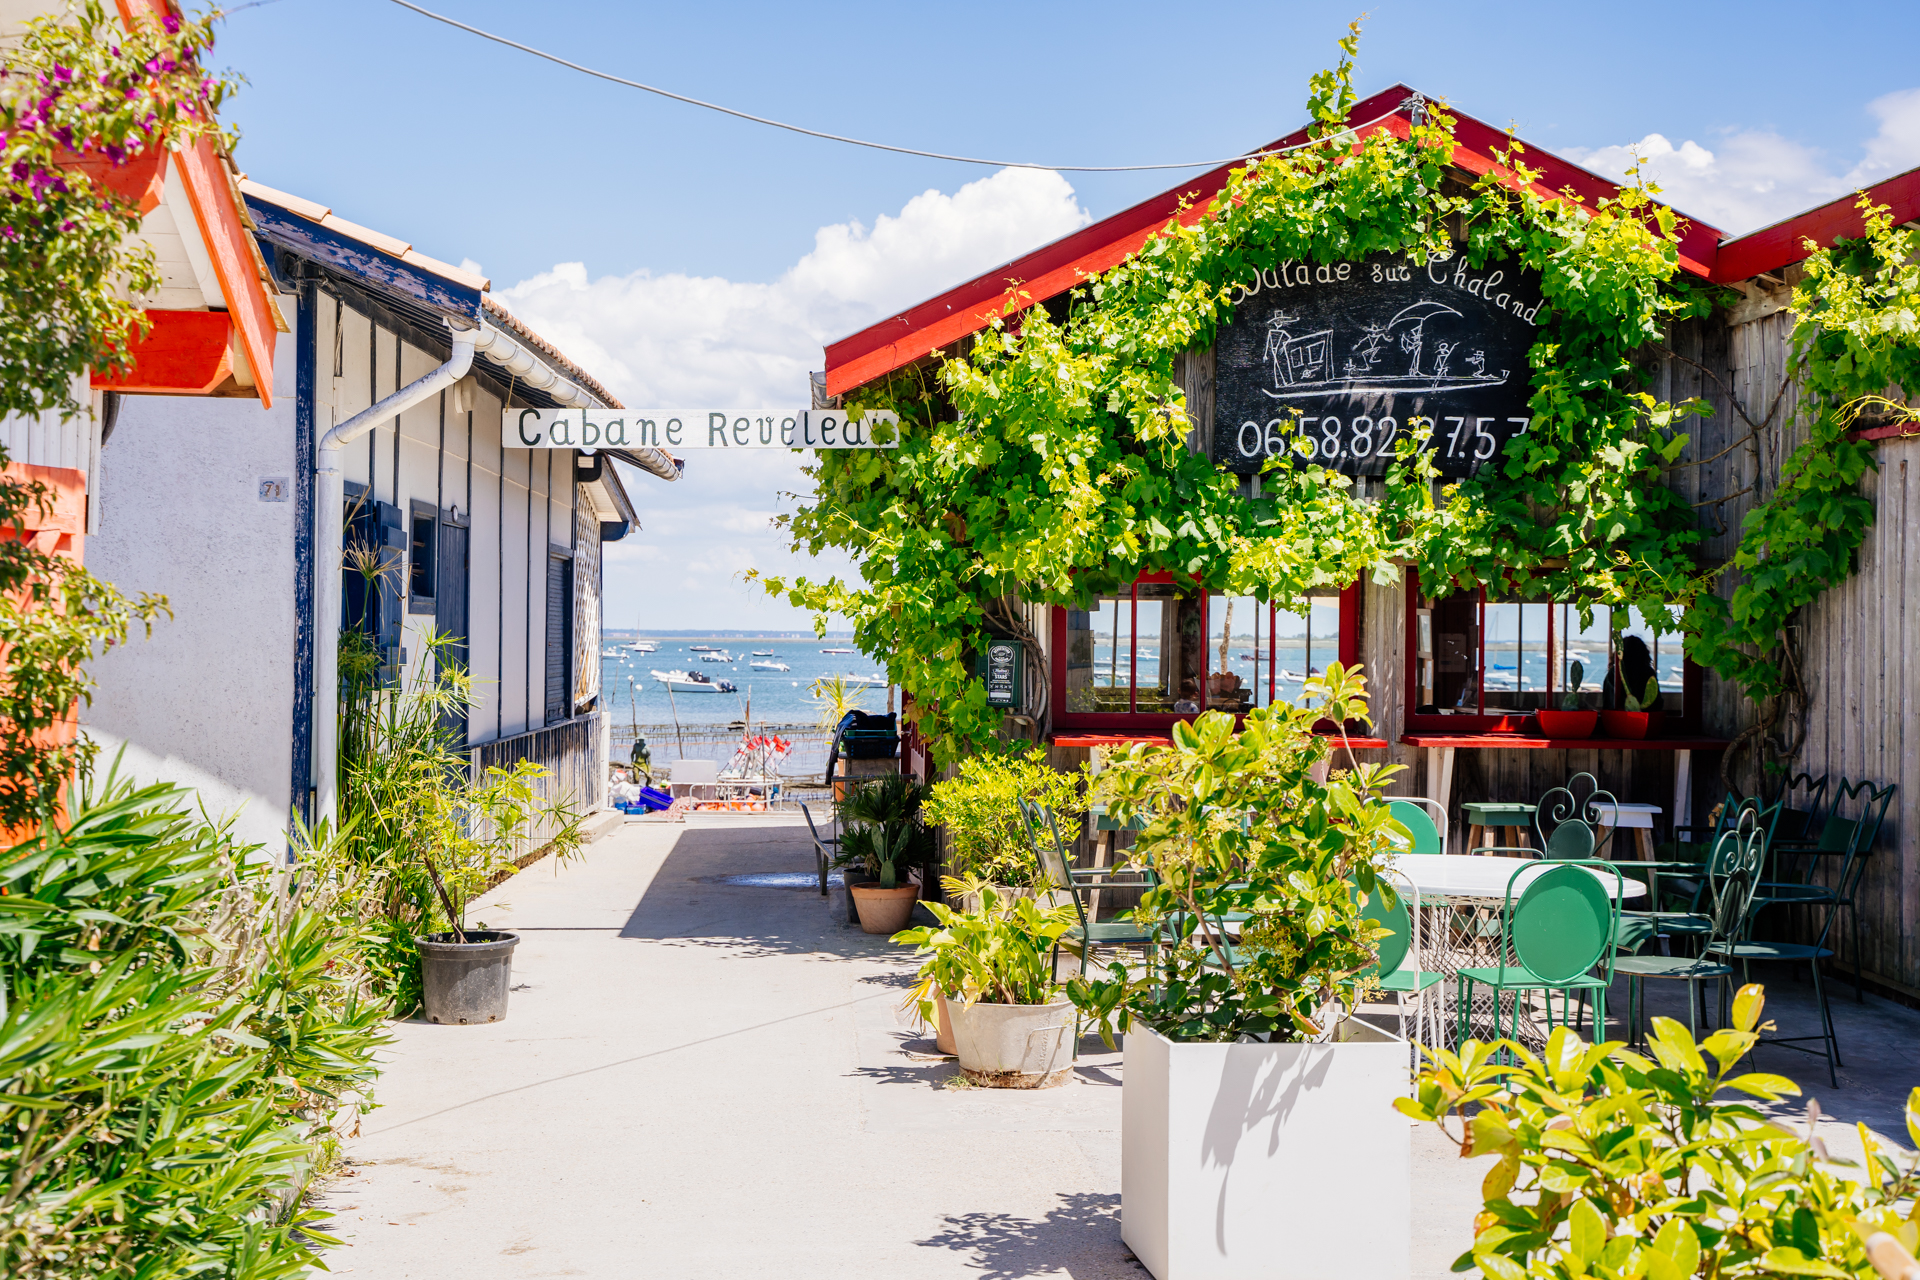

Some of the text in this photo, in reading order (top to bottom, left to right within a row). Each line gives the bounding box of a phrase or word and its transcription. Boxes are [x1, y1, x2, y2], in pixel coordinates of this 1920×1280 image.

[1370, 263, 1411, 283] sur
[1426, 248, 1544, 327] Chaland
[518, 408, 893, 446] Cabane Revelea
